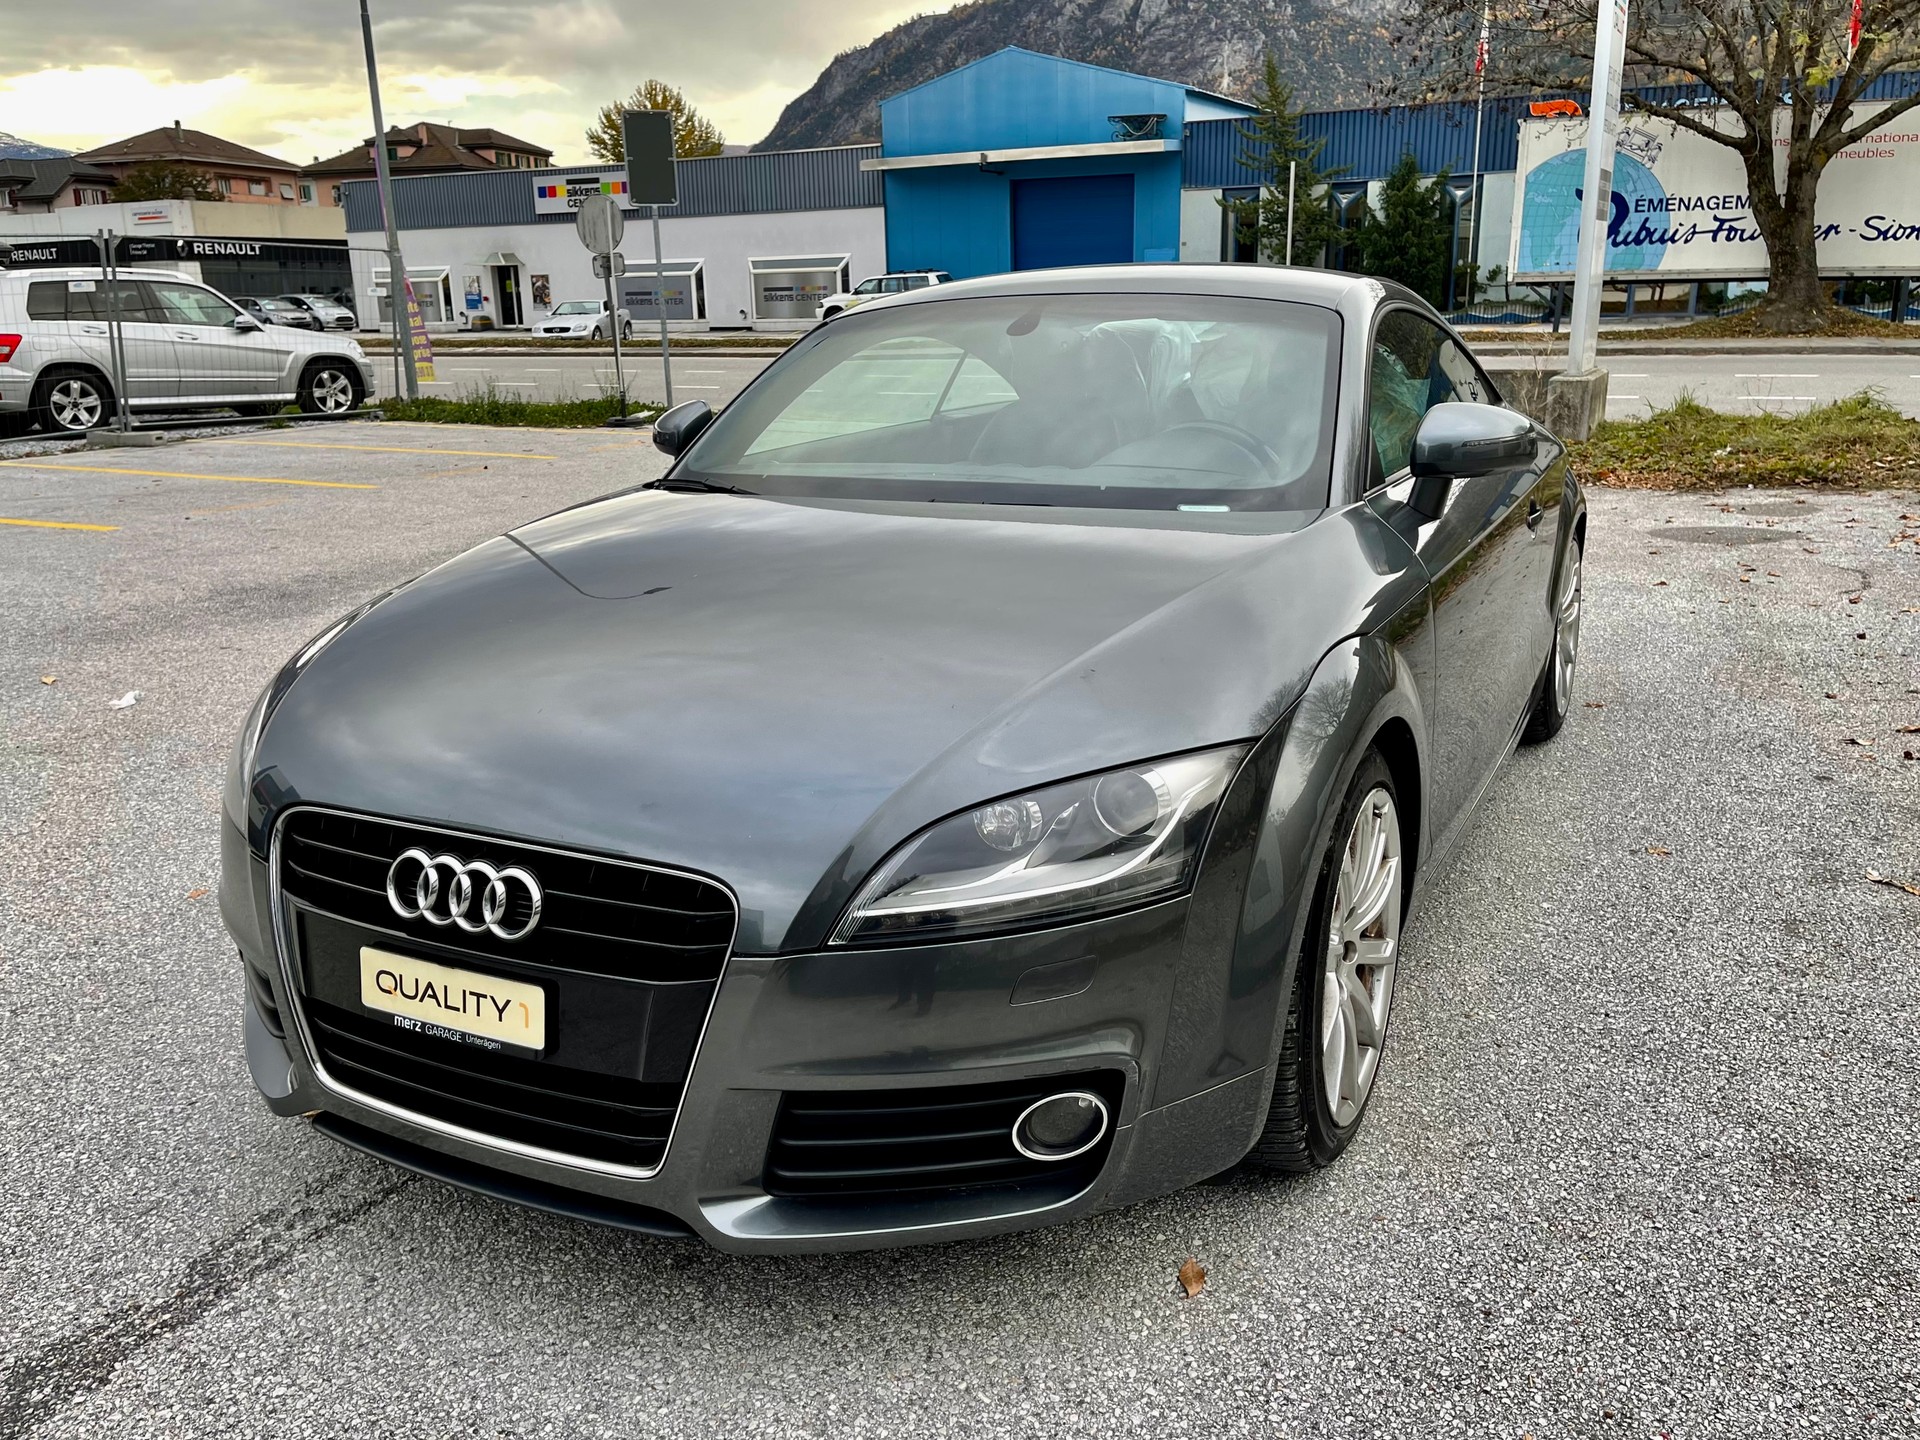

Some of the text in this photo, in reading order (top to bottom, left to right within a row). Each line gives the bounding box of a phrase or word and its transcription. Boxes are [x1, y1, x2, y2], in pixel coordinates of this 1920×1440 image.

[1835, 148, 1896, 160] meubles
[567, 186, 600, 198] sikkens
[11, 248, 57, 261] RENAULT
[193, 242, 262, 255] RENAULT
[625, 297, 684, 306] sikkens CNTER
[764, 292, 829, 303] sikkens CENTER
[376, 969, 512, 1023] QUALITY
[394, 1015, 422, 1032] merz
[425, 1024, 462, 1043] GARAGE
